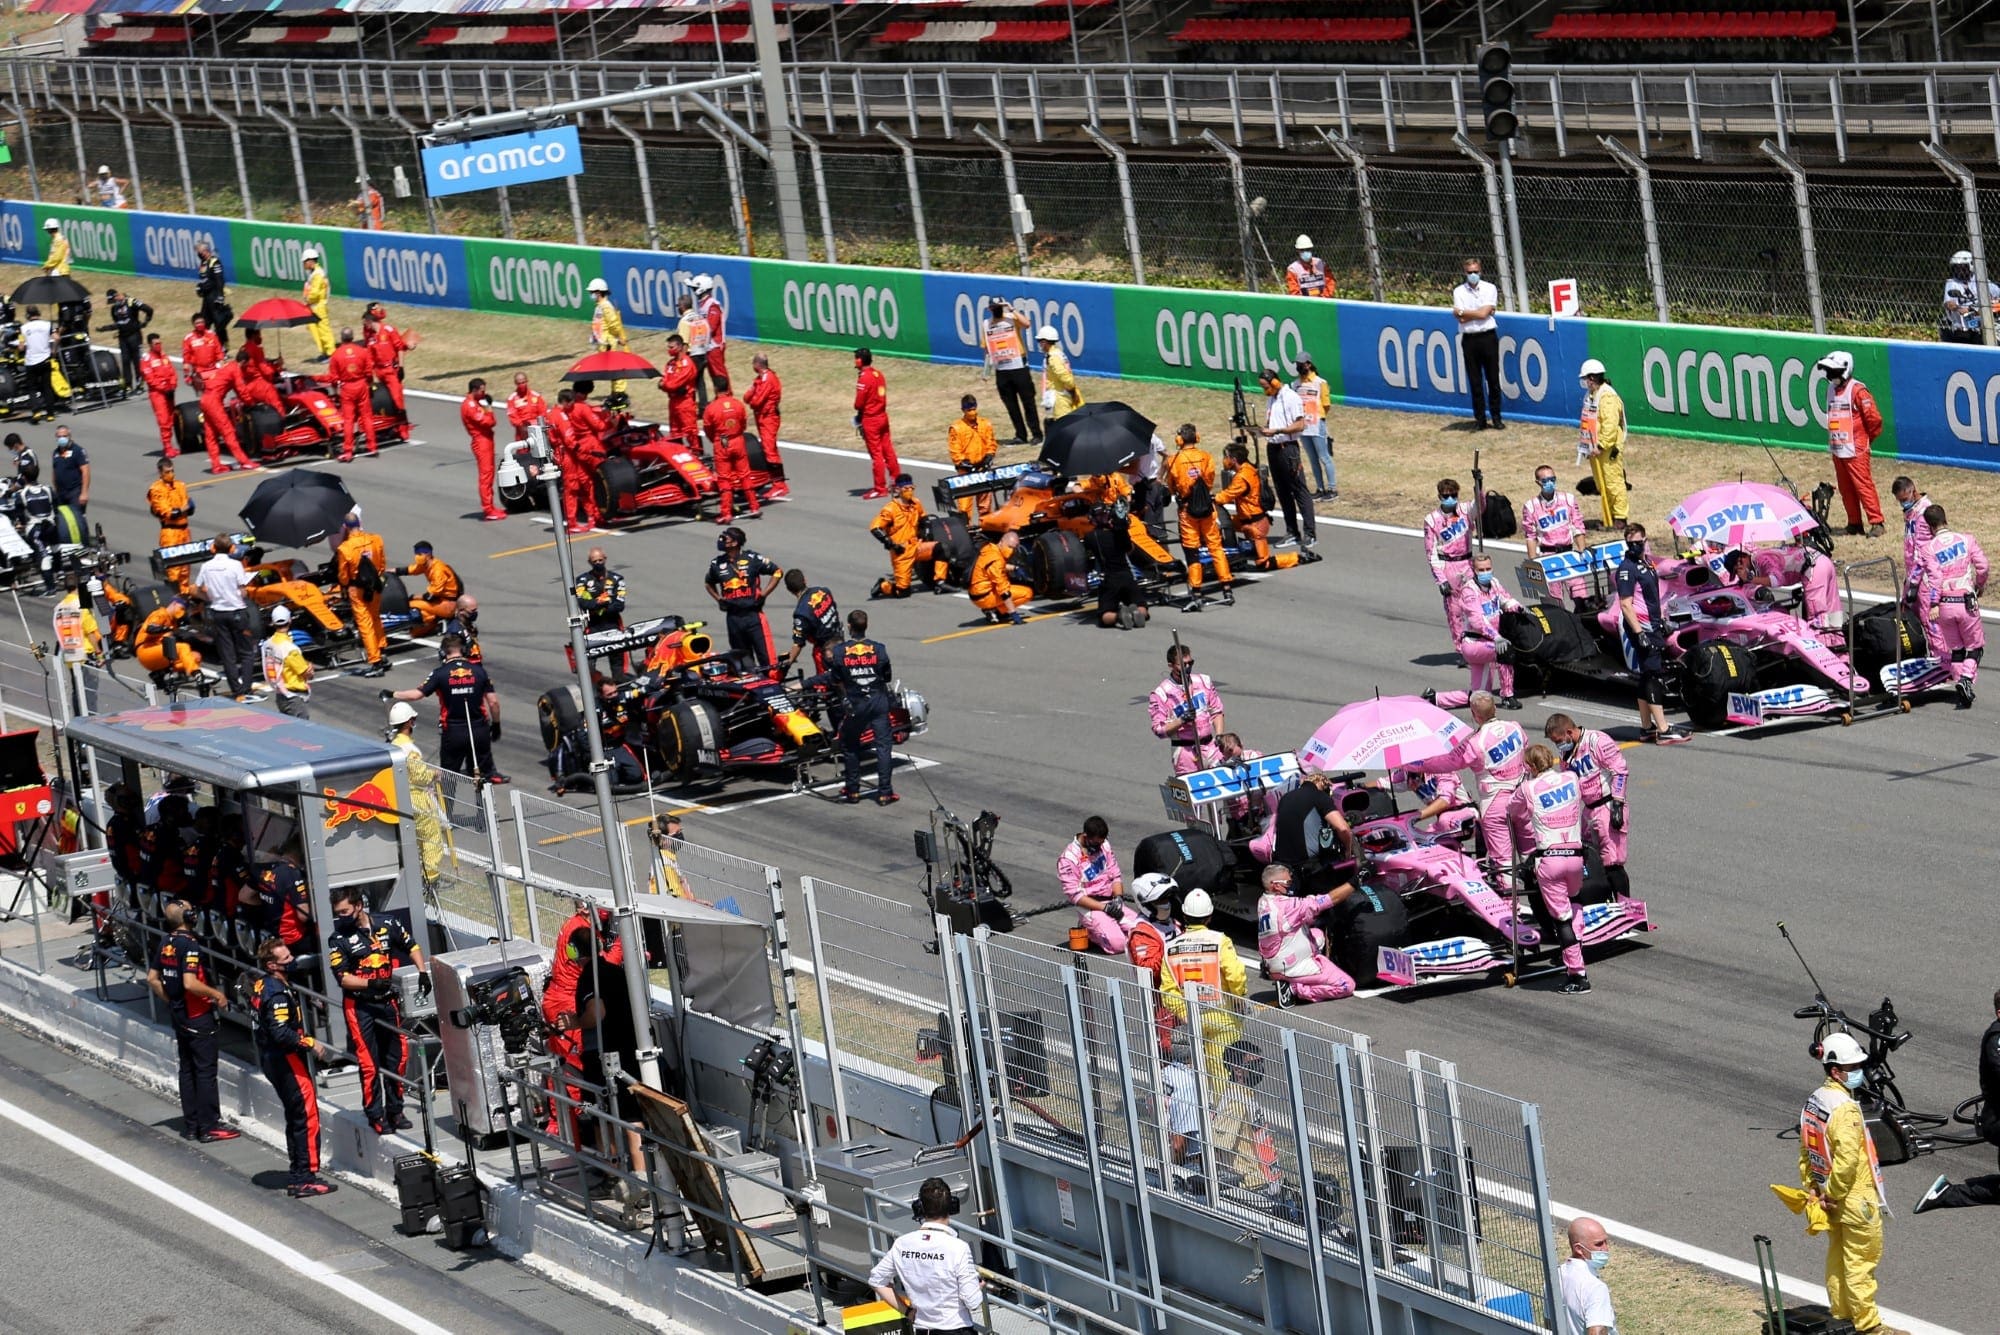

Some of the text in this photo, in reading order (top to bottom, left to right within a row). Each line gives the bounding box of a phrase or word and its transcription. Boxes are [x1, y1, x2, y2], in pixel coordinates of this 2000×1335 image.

[438, 142, 566, 181] aramco
[61, 218, 118, 262] ramco
[251, 236, 328, 282] aramo
[363, 246, 448, 297] aramco
[489, 256, 583, 309] aramco
[626, 267, 729, 320] aramo
[1552, 284, 1571, 312] F
[783, 280, 900, 340] aramco
[955, 293, 1085, 357] armco
[1156, 308, 1304, 377] aramco
[1378, 326, 1548, 402] araco
[1440, 517, 1467, 542] BWT
[1538, 509, 1568, 529] BWT
[1706, 503, 1765, 532] BWT
[1541, 543, 1626, 579] BWT
[1935, 541, 1967, 564] BWT
[844, 656, 877, 666] Red Bull
[1733, 695, 1761, 716] BWT
[1351, 723, 1415, 761] MAGNESIUM
[1488, 730, 1522, 764] BWT
[1187, 757, 1285, 800] BWT
[1571, 754, 1594, 777] WT
[1539, 782, 1577, 809] BWT
[1383, 951, 1413, 977] BWT
[901, 1250, 945, 1262] PETRONAS
